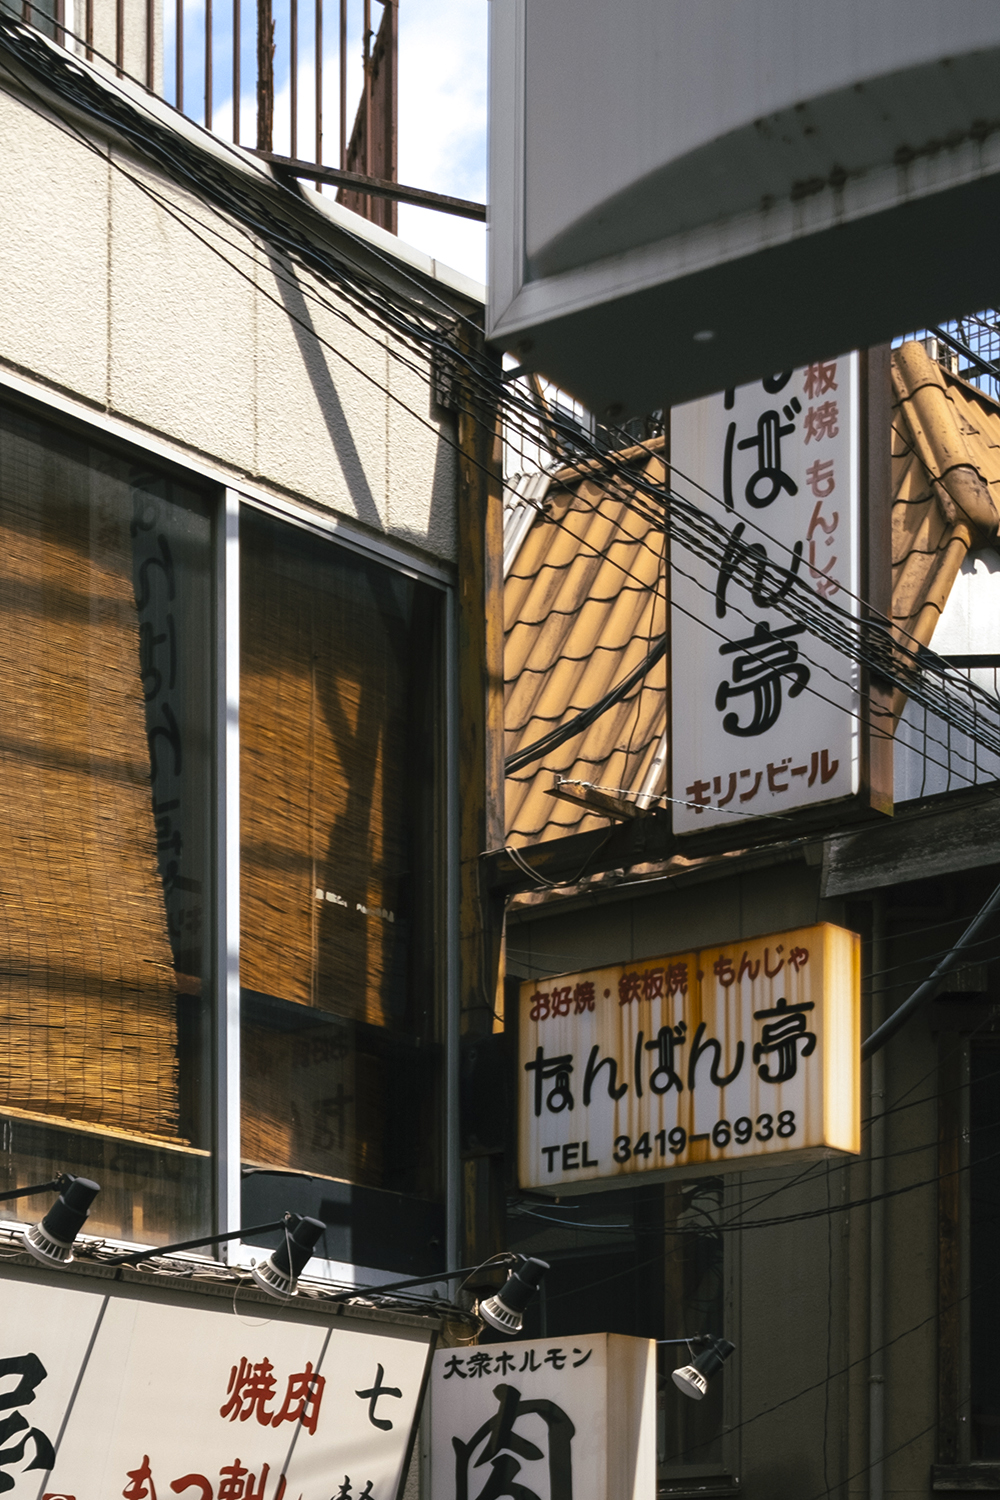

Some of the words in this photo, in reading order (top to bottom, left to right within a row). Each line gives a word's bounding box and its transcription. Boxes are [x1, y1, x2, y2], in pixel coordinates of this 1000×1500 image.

[686, 748, 839, 814] キリンビール
[524, 998, 817, 1117] なんばん亭
[542, 1141, 598, 1173] TEL
[613, 1110, 797, 1164] 3419-6938
[220, 1355, 326, 1436] 焼肉
[442, 1348, 593, 1379] 大衆ホルモン
